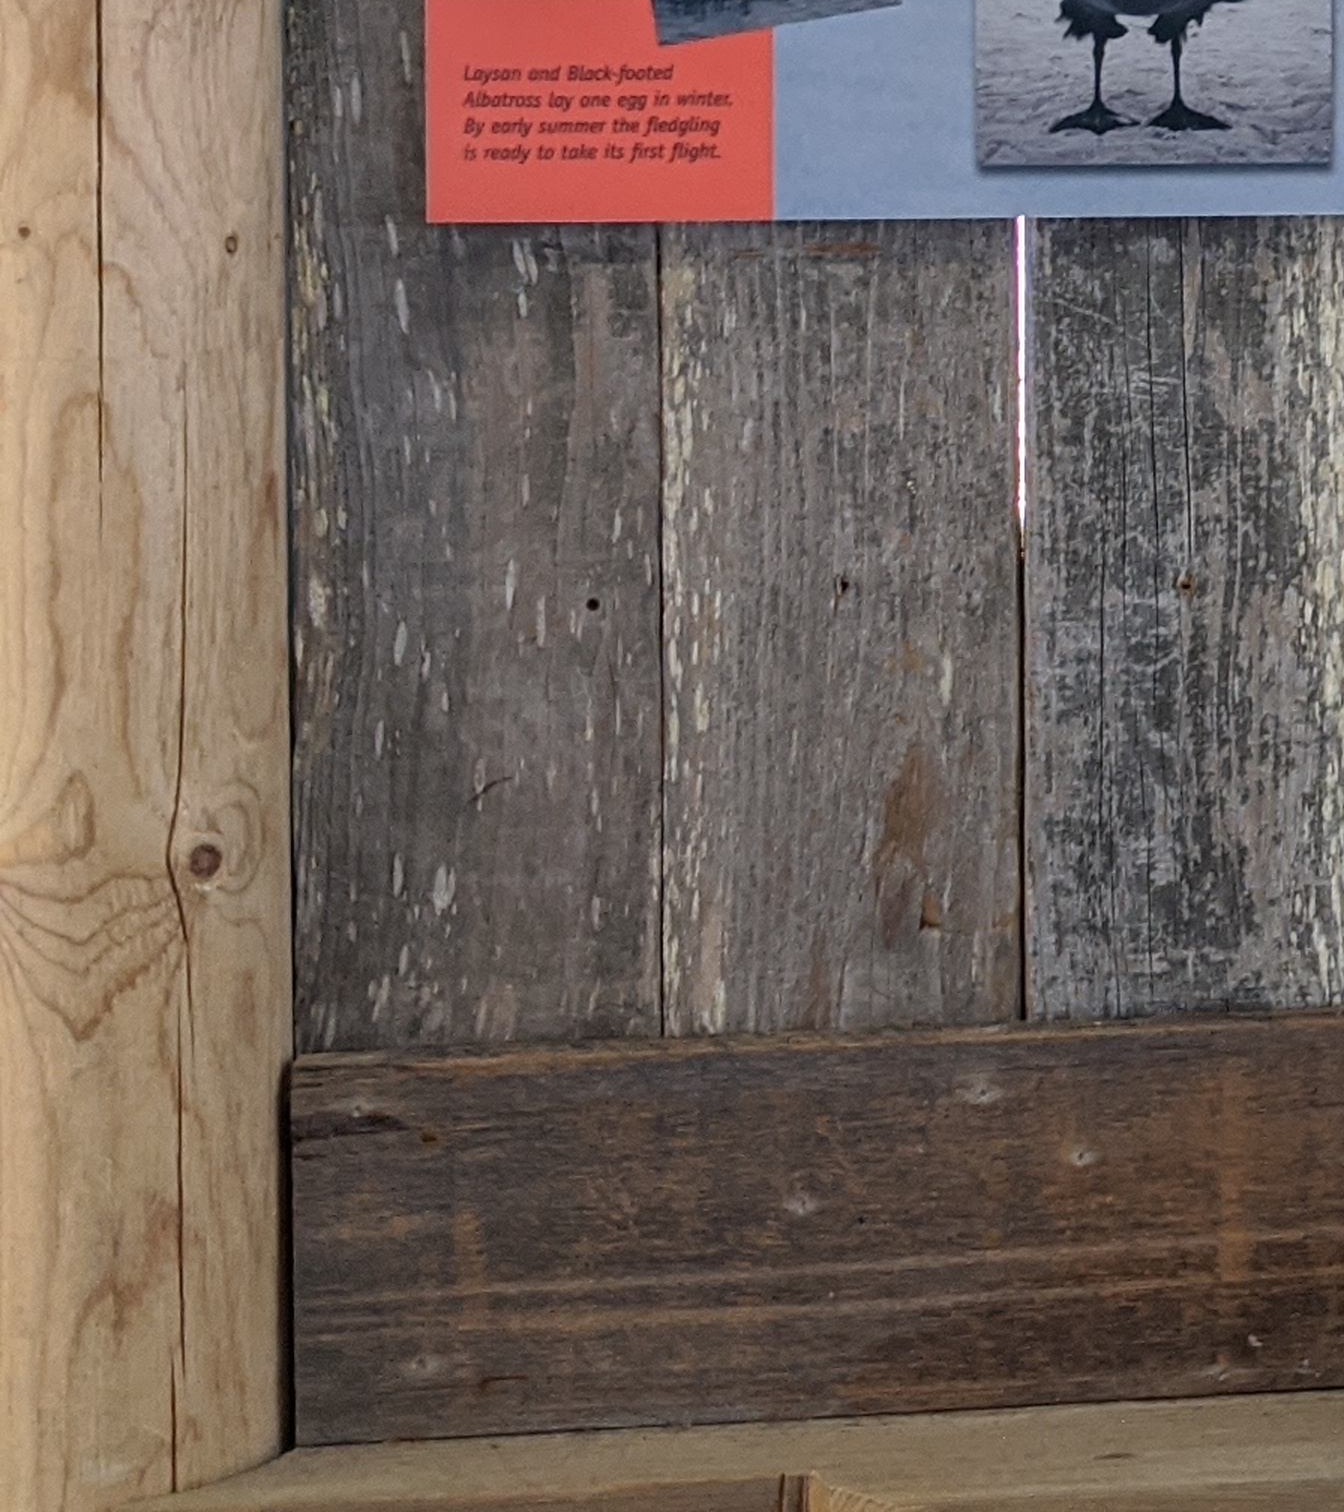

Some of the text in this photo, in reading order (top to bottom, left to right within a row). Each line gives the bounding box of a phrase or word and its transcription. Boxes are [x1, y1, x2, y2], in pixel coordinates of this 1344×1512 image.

[463, 64, 674, 86] Laysan and Black-footed
[462, 90, 542, 109] Albatross
[547, 91, 575, 112] lay
[579, 95, 611, 108] one
[617, 95, 648, 112] egg
[653, 90, 670, 107] in
[463, 115, 721, 138] By early summer the fledgling
[464, 143, 477, 161] is
[483, 144, 531, 164] ready
[536, 145, 555, 160] to
[561, 144, 598, 160] take
[603, 142, 625, 160] its
[628, 142, 666, 163] first
